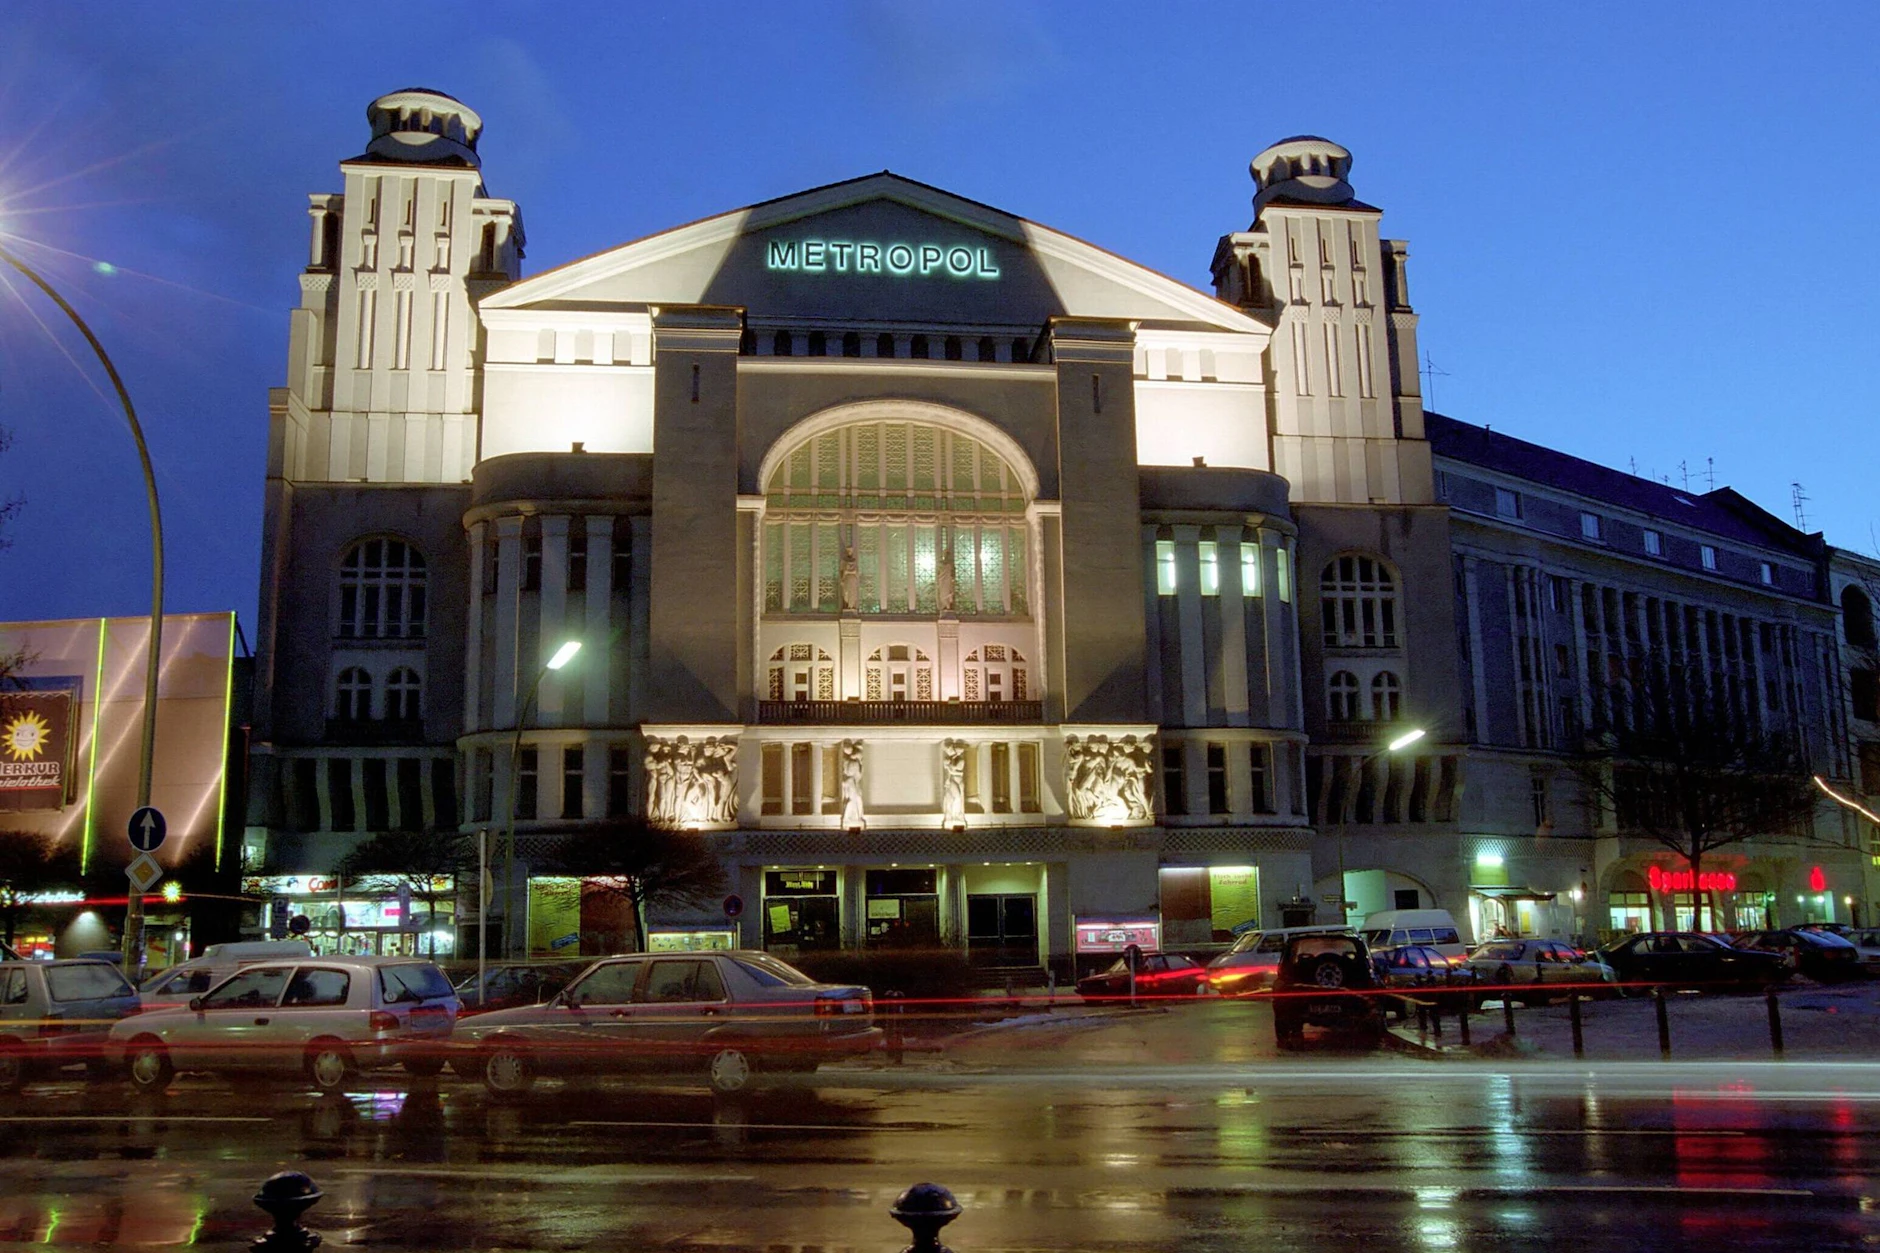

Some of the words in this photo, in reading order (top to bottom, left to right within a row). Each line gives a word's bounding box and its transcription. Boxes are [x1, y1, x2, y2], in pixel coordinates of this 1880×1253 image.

[768, 241, 999, 277] METROPOL
[0, 761, 60, 776] ERKUR
[0, 775, 61, 787] ielothek
